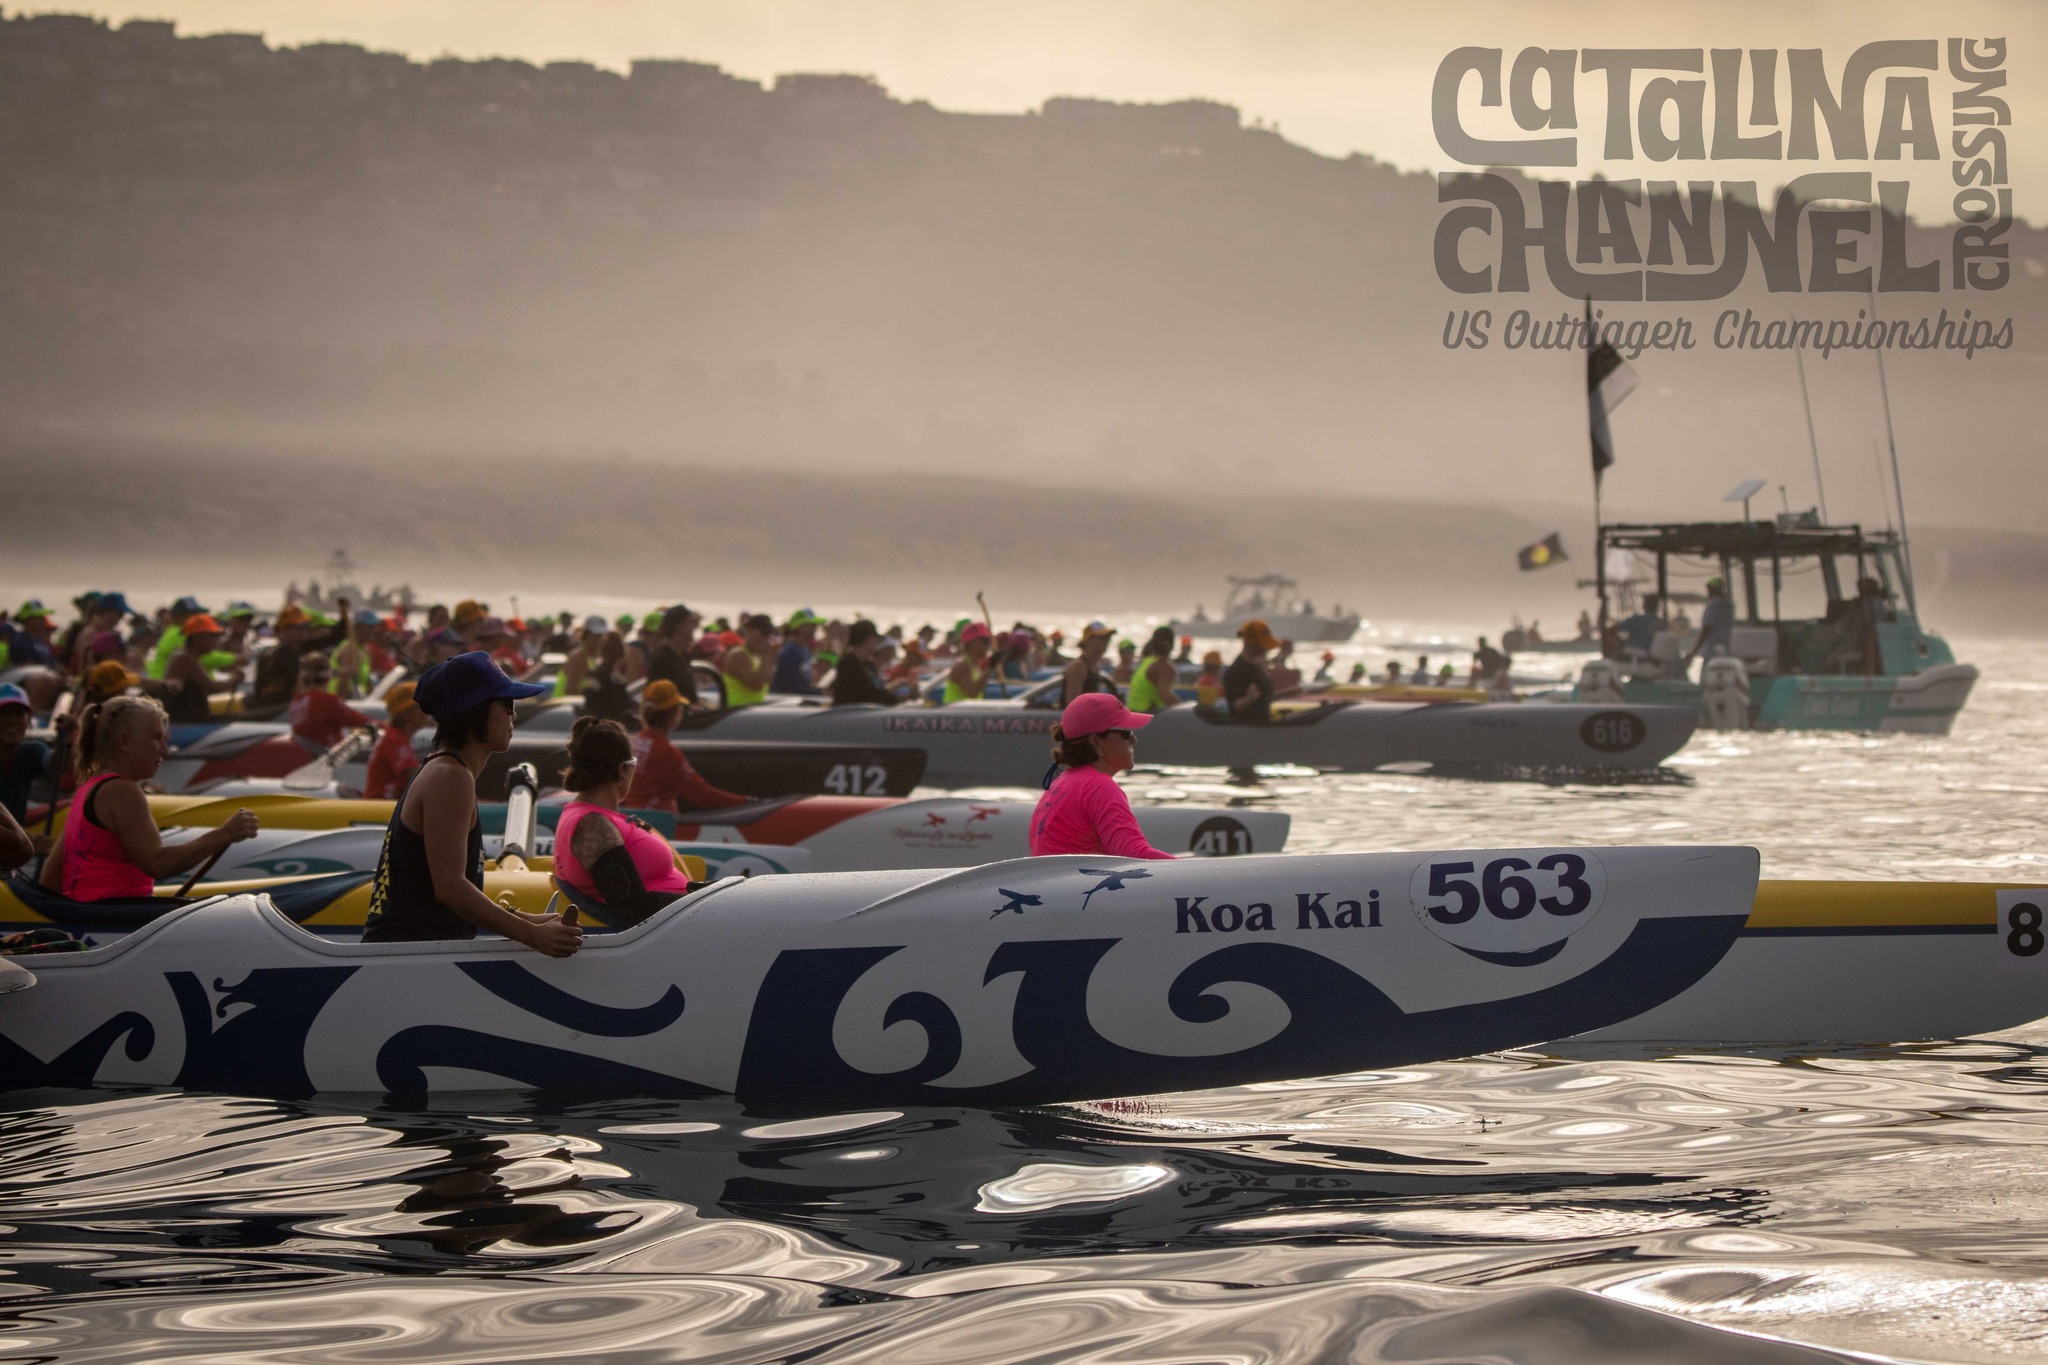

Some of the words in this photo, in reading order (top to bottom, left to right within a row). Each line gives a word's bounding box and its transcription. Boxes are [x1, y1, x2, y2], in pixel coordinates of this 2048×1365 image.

[1593, 719, 1633, 743] 616
[824, 764, 887, 795] 412
[1194, 831, 1247, 855] 411
[1427, 854, 1592, 925] 563
[1174, 896, 1276, 934] Koa
[1295, 889, 1383, 930] Kai
[2007, 902, 2045, 957] 8
